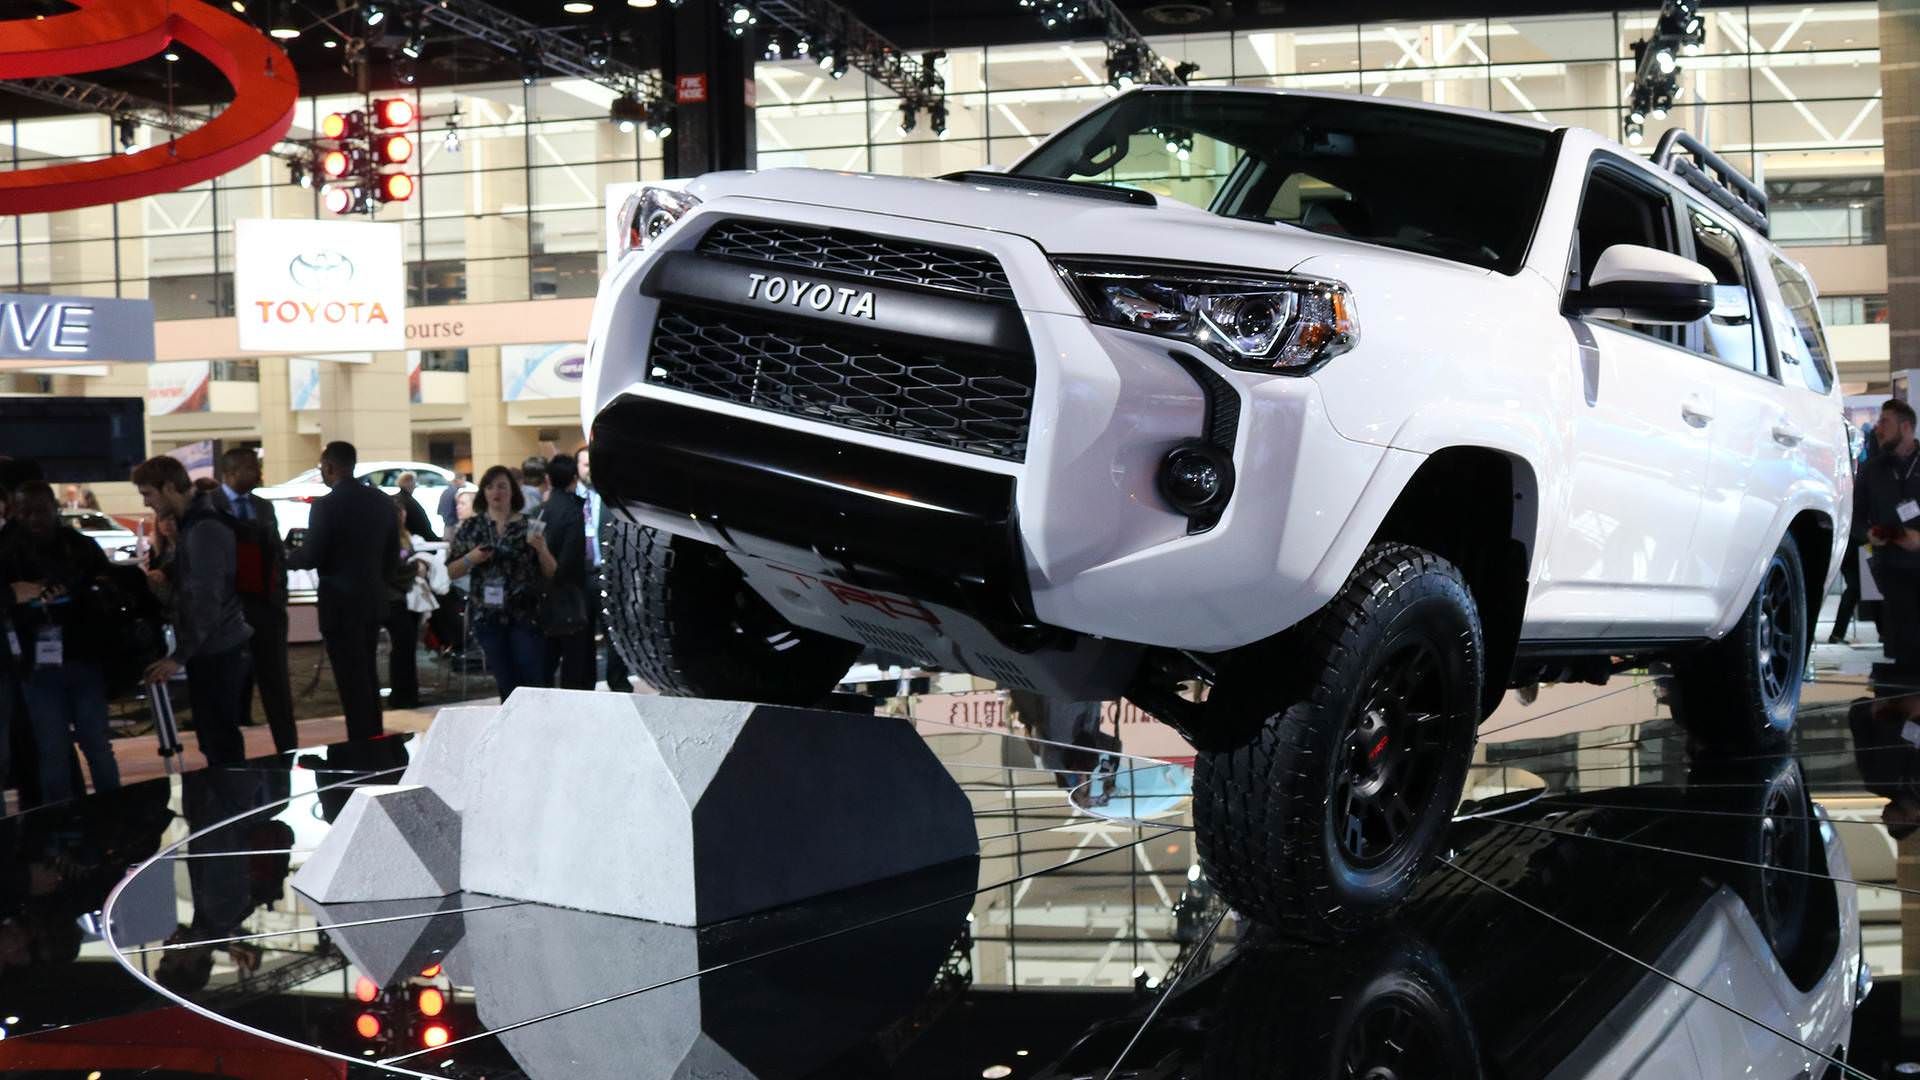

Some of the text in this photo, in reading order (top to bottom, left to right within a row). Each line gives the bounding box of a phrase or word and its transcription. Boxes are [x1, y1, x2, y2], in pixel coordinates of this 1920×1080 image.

[255, 300, 388, 324] TOYOTA
[748, 272, 876, 320] TOYOTA
[0, 300, 94, 352] VE
[404, 321, 464, 340] ourse
